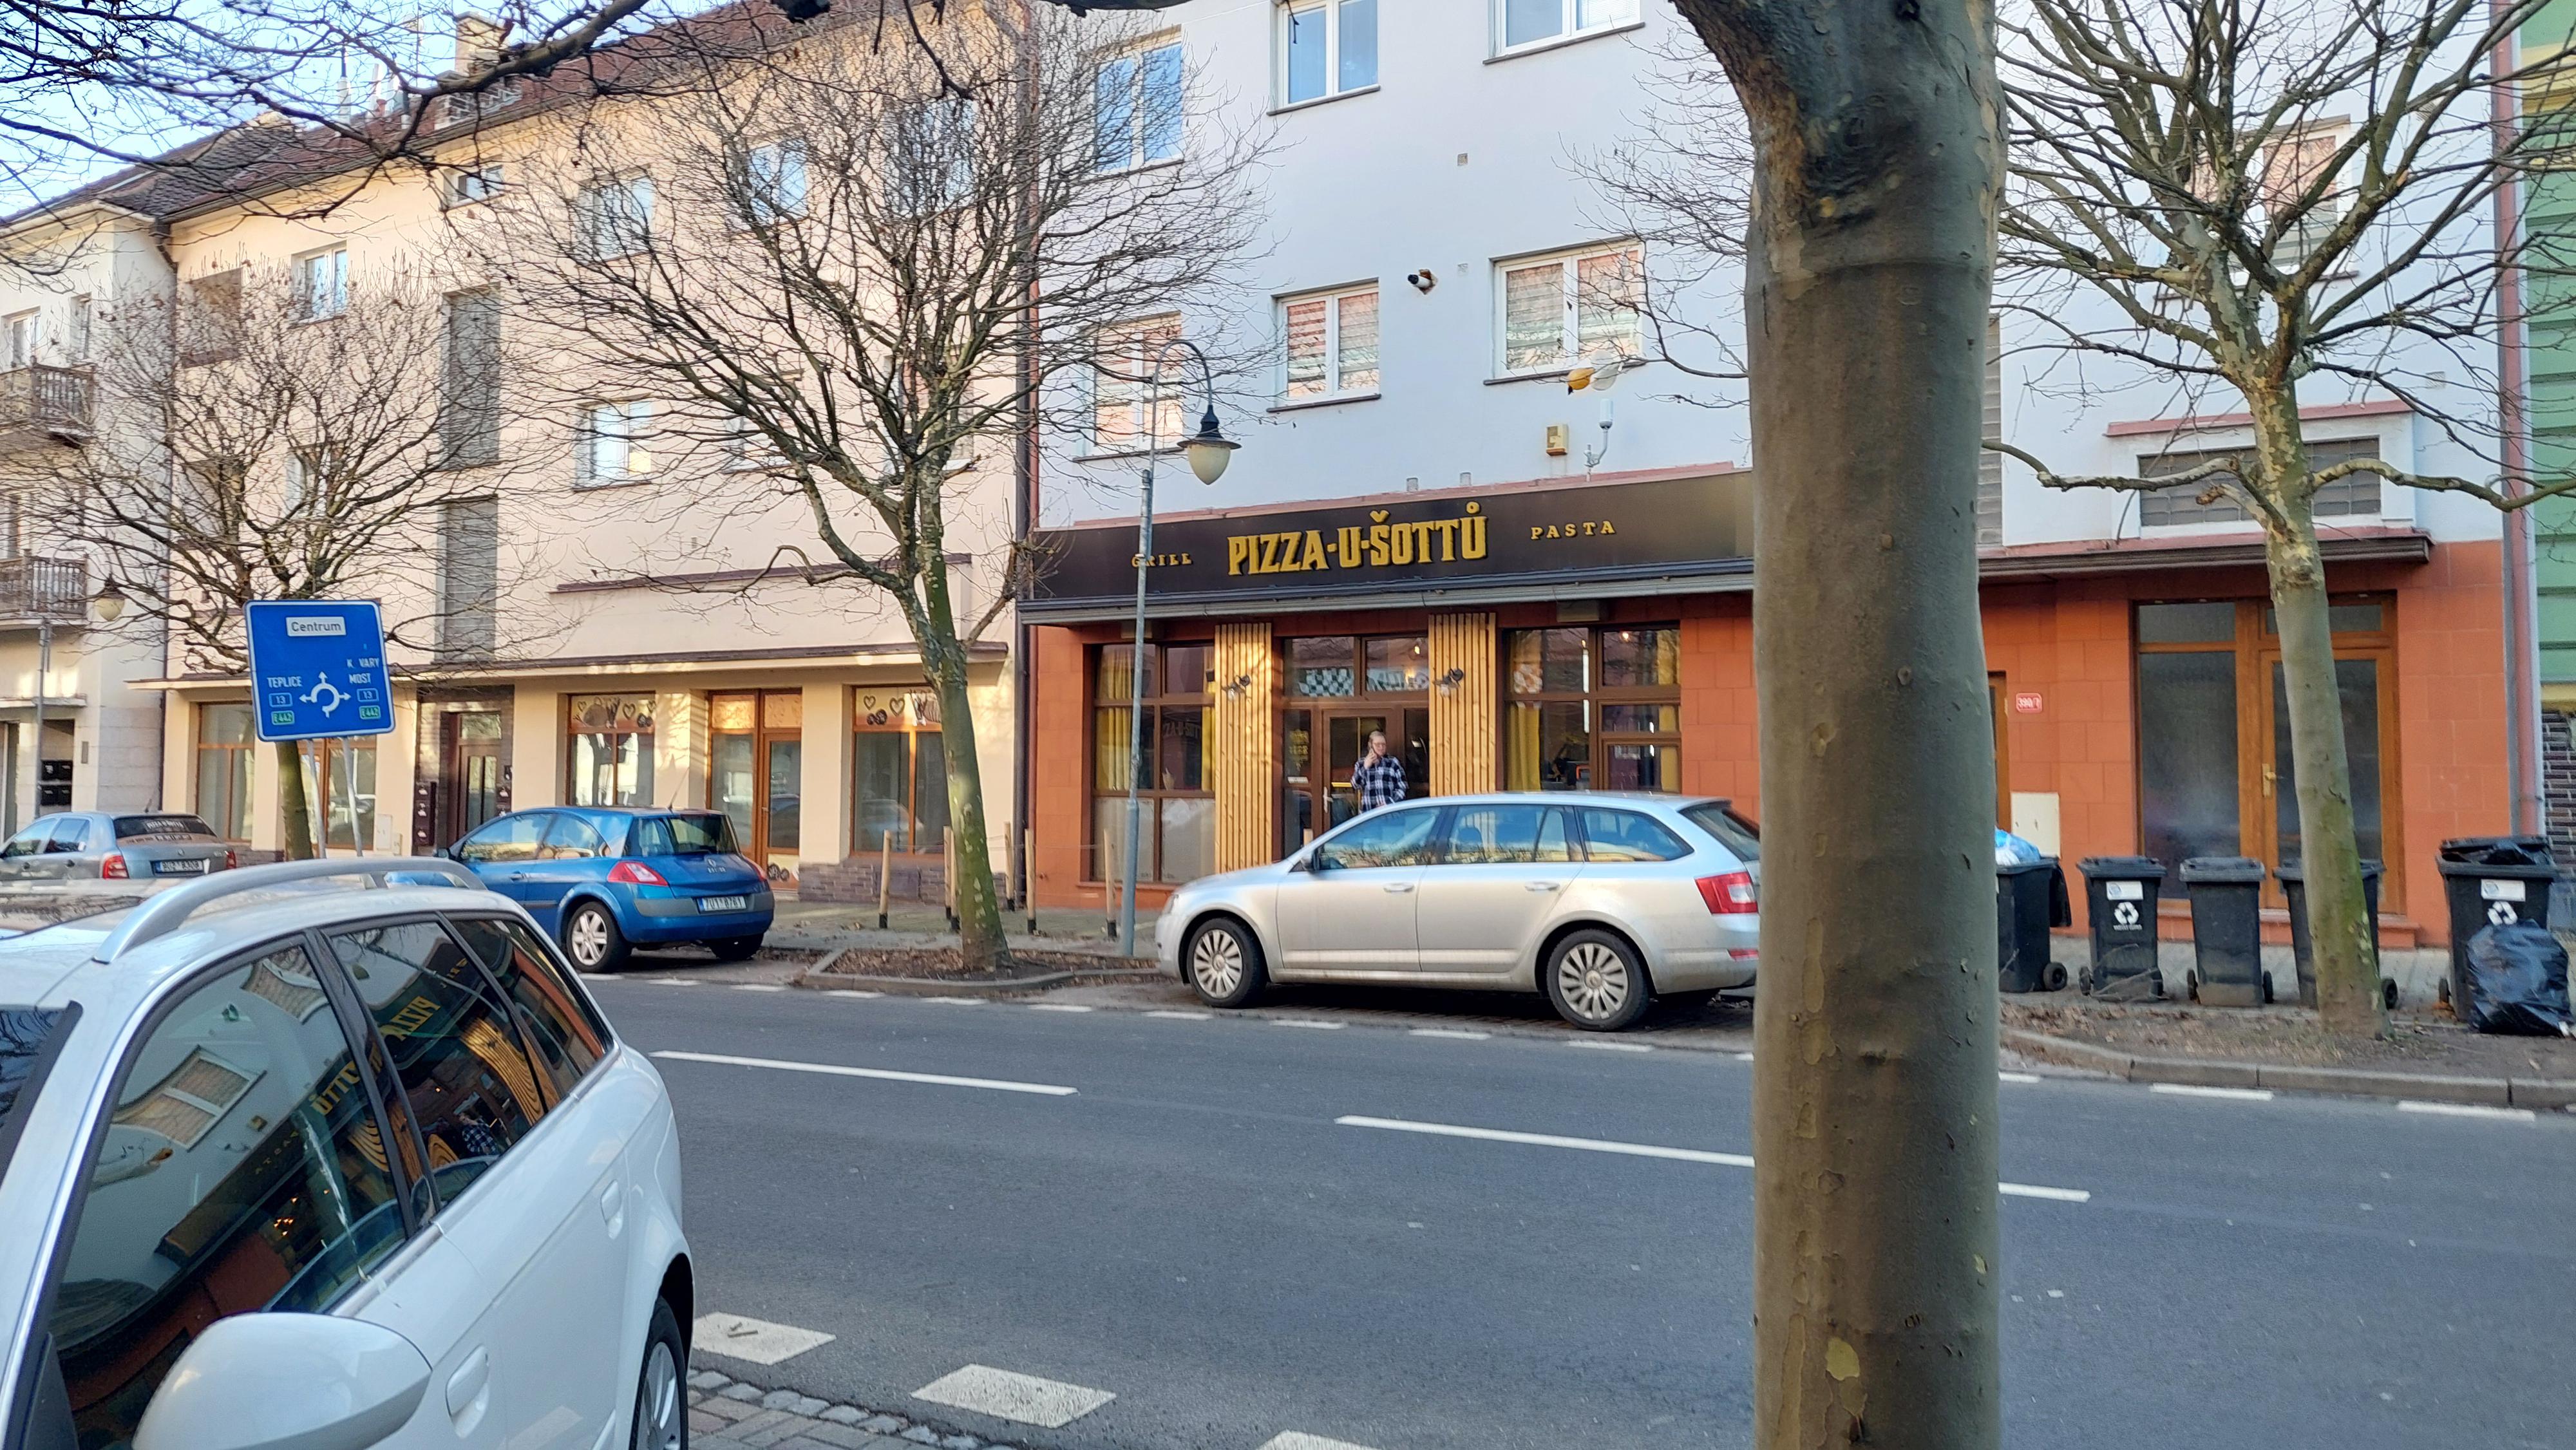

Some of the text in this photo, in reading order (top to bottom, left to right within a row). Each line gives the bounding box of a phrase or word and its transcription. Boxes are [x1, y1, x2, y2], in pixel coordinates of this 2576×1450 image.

[1531, 520, 1616, 540] PASTA
[290, 621, 342, 632] Centrum
[358, 657, 379, 668] VARY
[267, 676, 303, 688] TEPLICE
[348, 673, 372, 684] MOST
[275, 695, 286, 704] 13
[363, 690, 373, 699] 13
